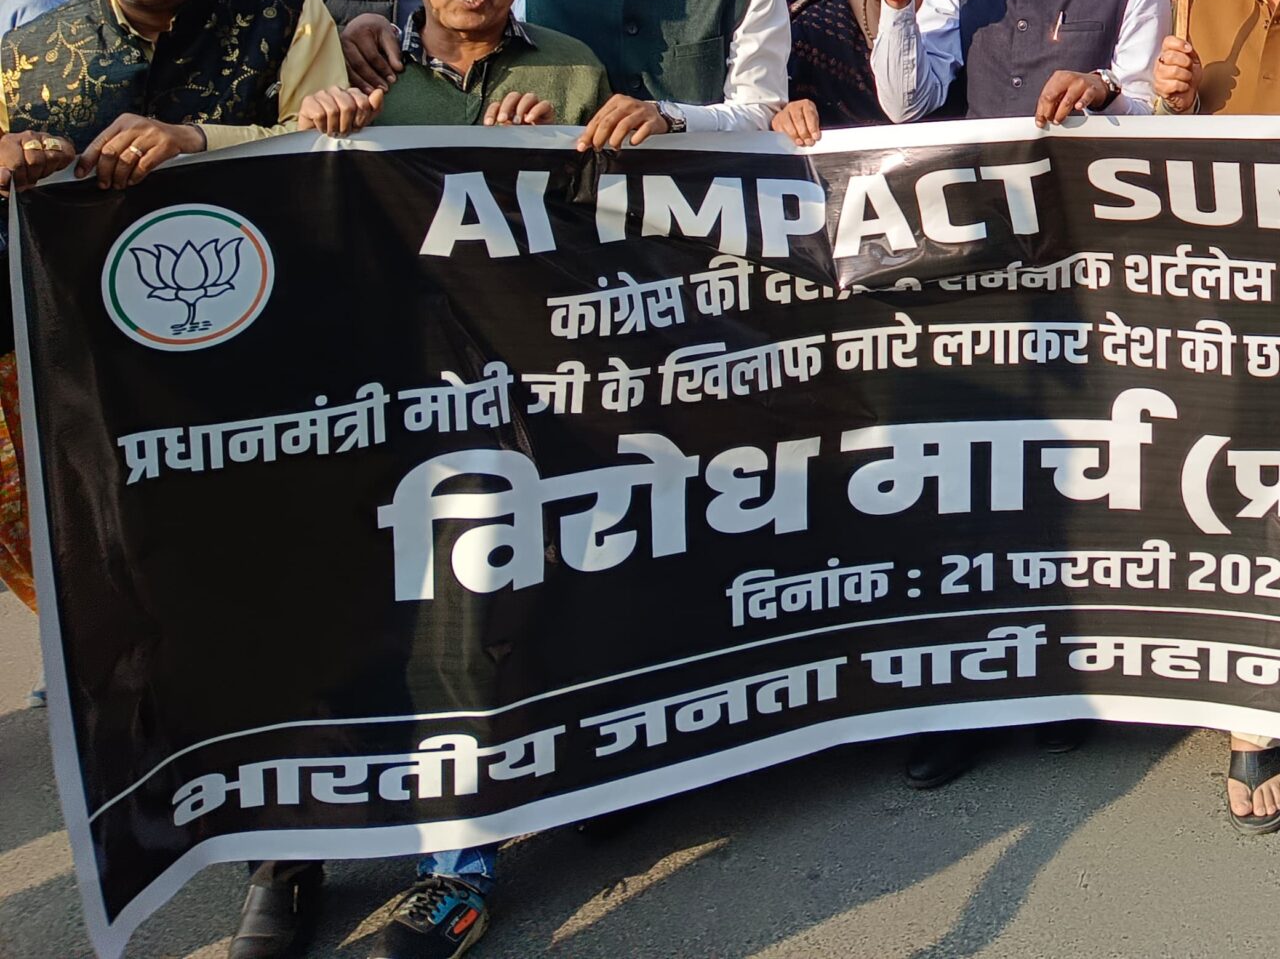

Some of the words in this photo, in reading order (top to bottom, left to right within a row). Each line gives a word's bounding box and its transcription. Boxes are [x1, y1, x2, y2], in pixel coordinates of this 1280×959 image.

[419, 170, 557, 259] AI
[595, 158, 1052, 260] IMPACT
[547, 271, 685, 340] कांग्रेस
[690, 255, 755, 311] की
[1125, 247, 1273, 304] शर्टलेस
[117, 381, 390, 485] प्रधानमंत्री
[398, 360, 514, 434] मोदी
[521, 360, 590, 415] जी
[599, 357, 645, 413] के
[658, 336, 826, 406] खिलाफ
[831, 312, 922, 373] नारे
[929, 321, 1092, 367] लगाकर
[1098, 311, 1171, 370] देश
[1180, 320, 1233, 375] की
[377, 432, 822, 604] विरोध
[839, 386, 1179, 516] मार्च
[726, 557, 895, 628] दिनांक
[939, 553, 994, 596] 21
[1007, 538, 1174, 593] फरवरी
[171, 725, 566, 827] भारतीय
[579, 656, 848, 749] जनता
[860, 622, 1048, 689] पार्टी
